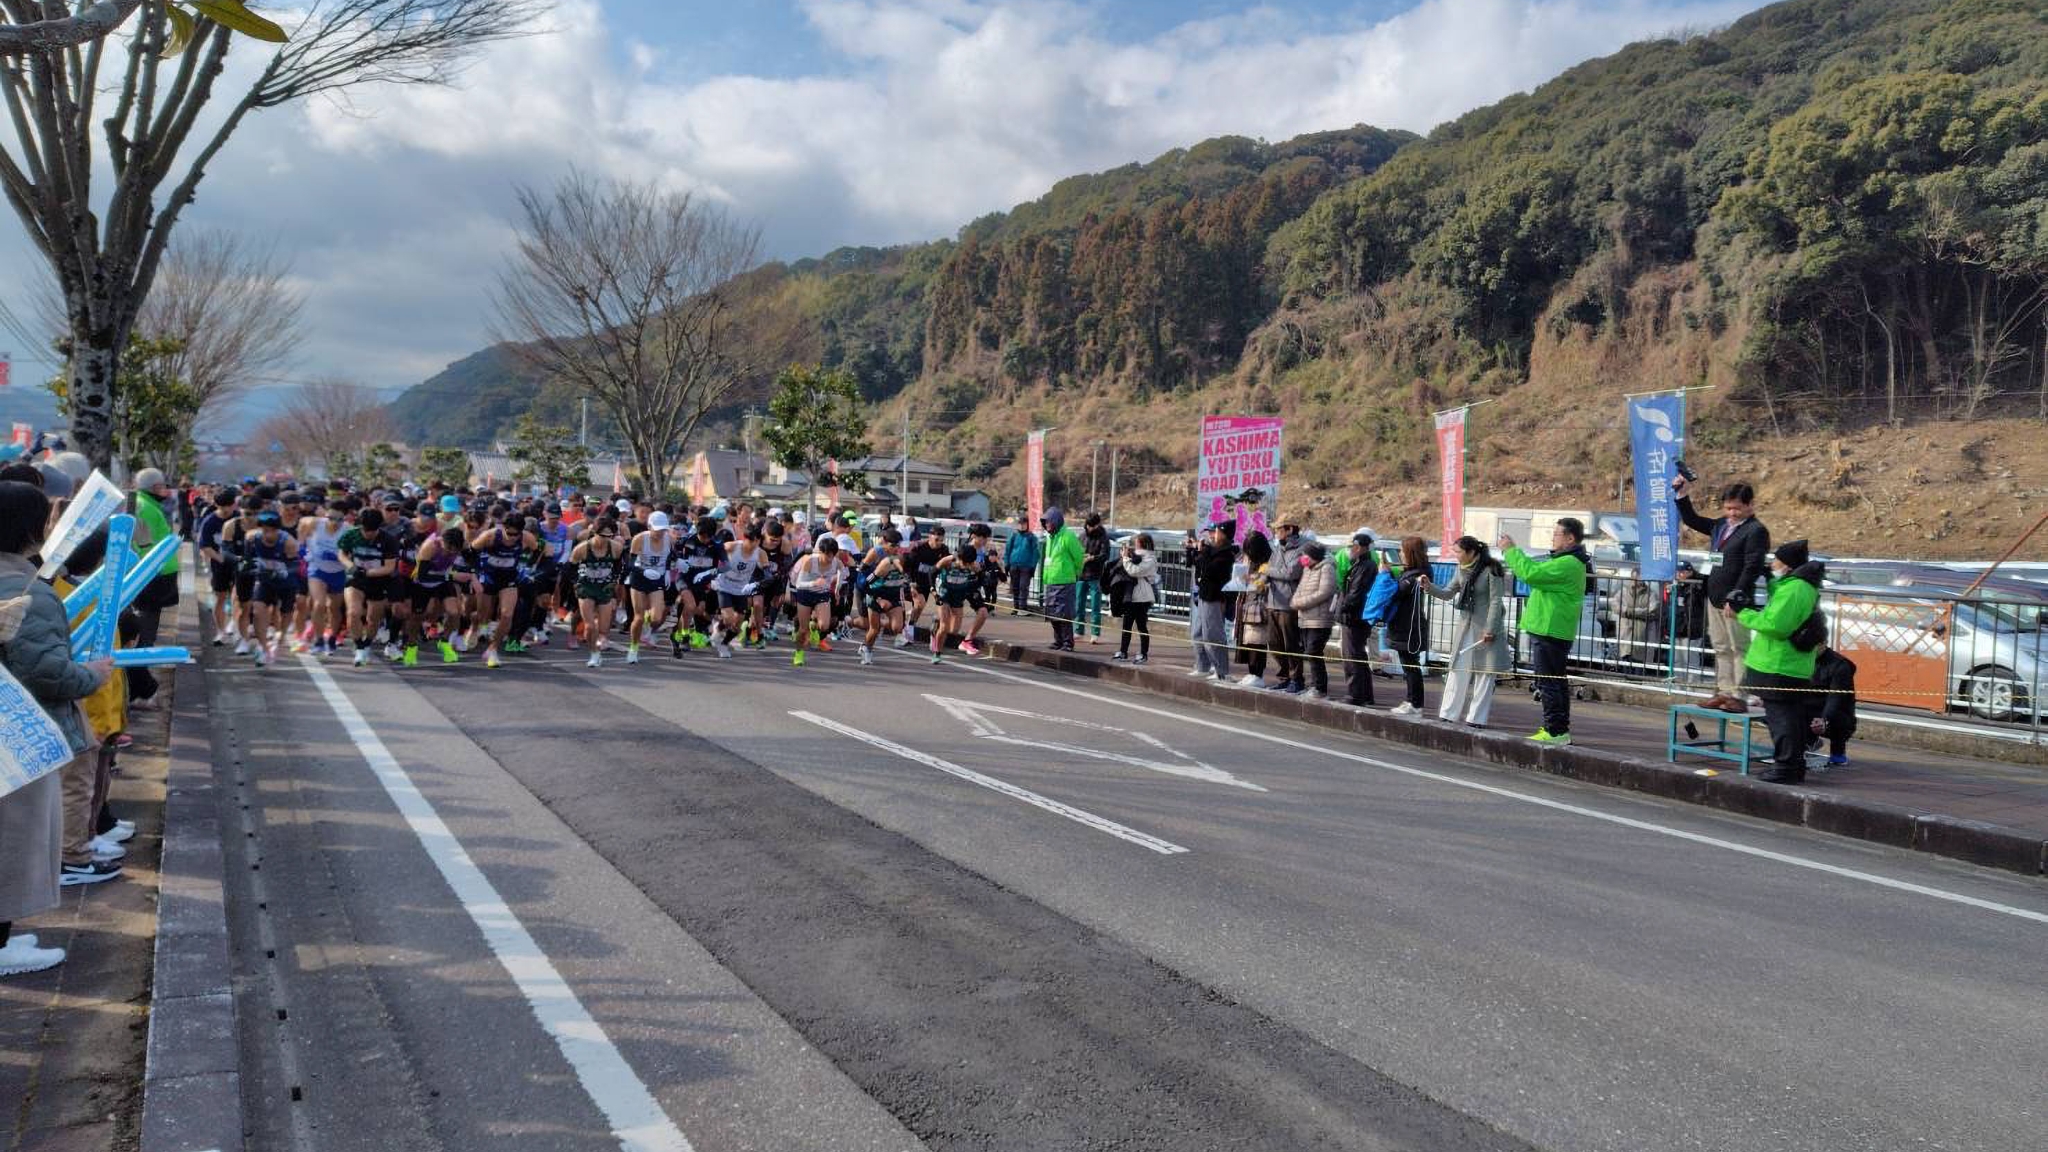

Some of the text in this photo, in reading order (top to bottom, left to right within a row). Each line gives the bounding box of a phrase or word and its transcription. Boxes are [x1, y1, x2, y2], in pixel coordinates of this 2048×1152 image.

[1203, 430, 1280, 456] KASHIMA
[1207, 451, 1274, 475] YUTOKU
[1200, 468, 1280, 492] ROAD RACE
